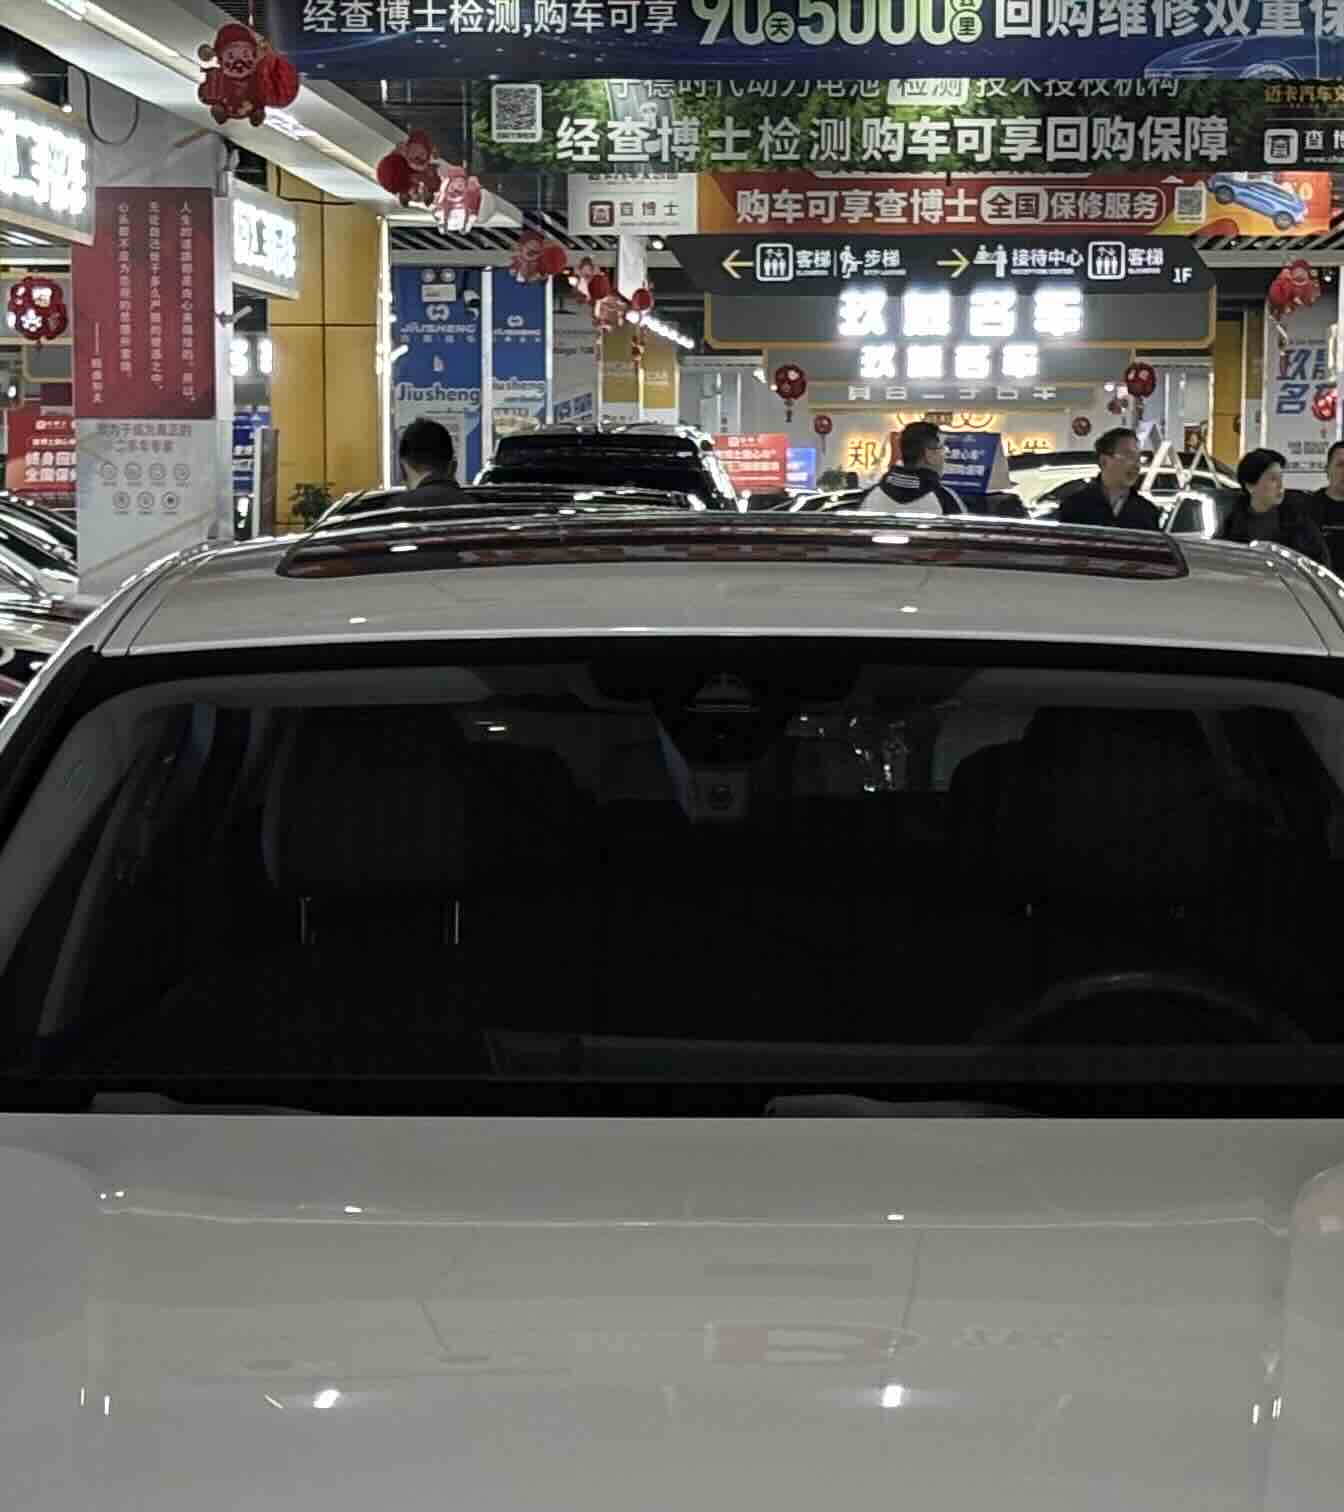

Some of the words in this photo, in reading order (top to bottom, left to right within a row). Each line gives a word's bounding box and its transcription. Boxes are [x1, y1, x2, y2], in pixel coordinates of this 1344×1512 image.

[556, 115, 1231, 163] 经查博士检测购车可享回购保障
[1011, 248, 1084, 267] 接待中心
